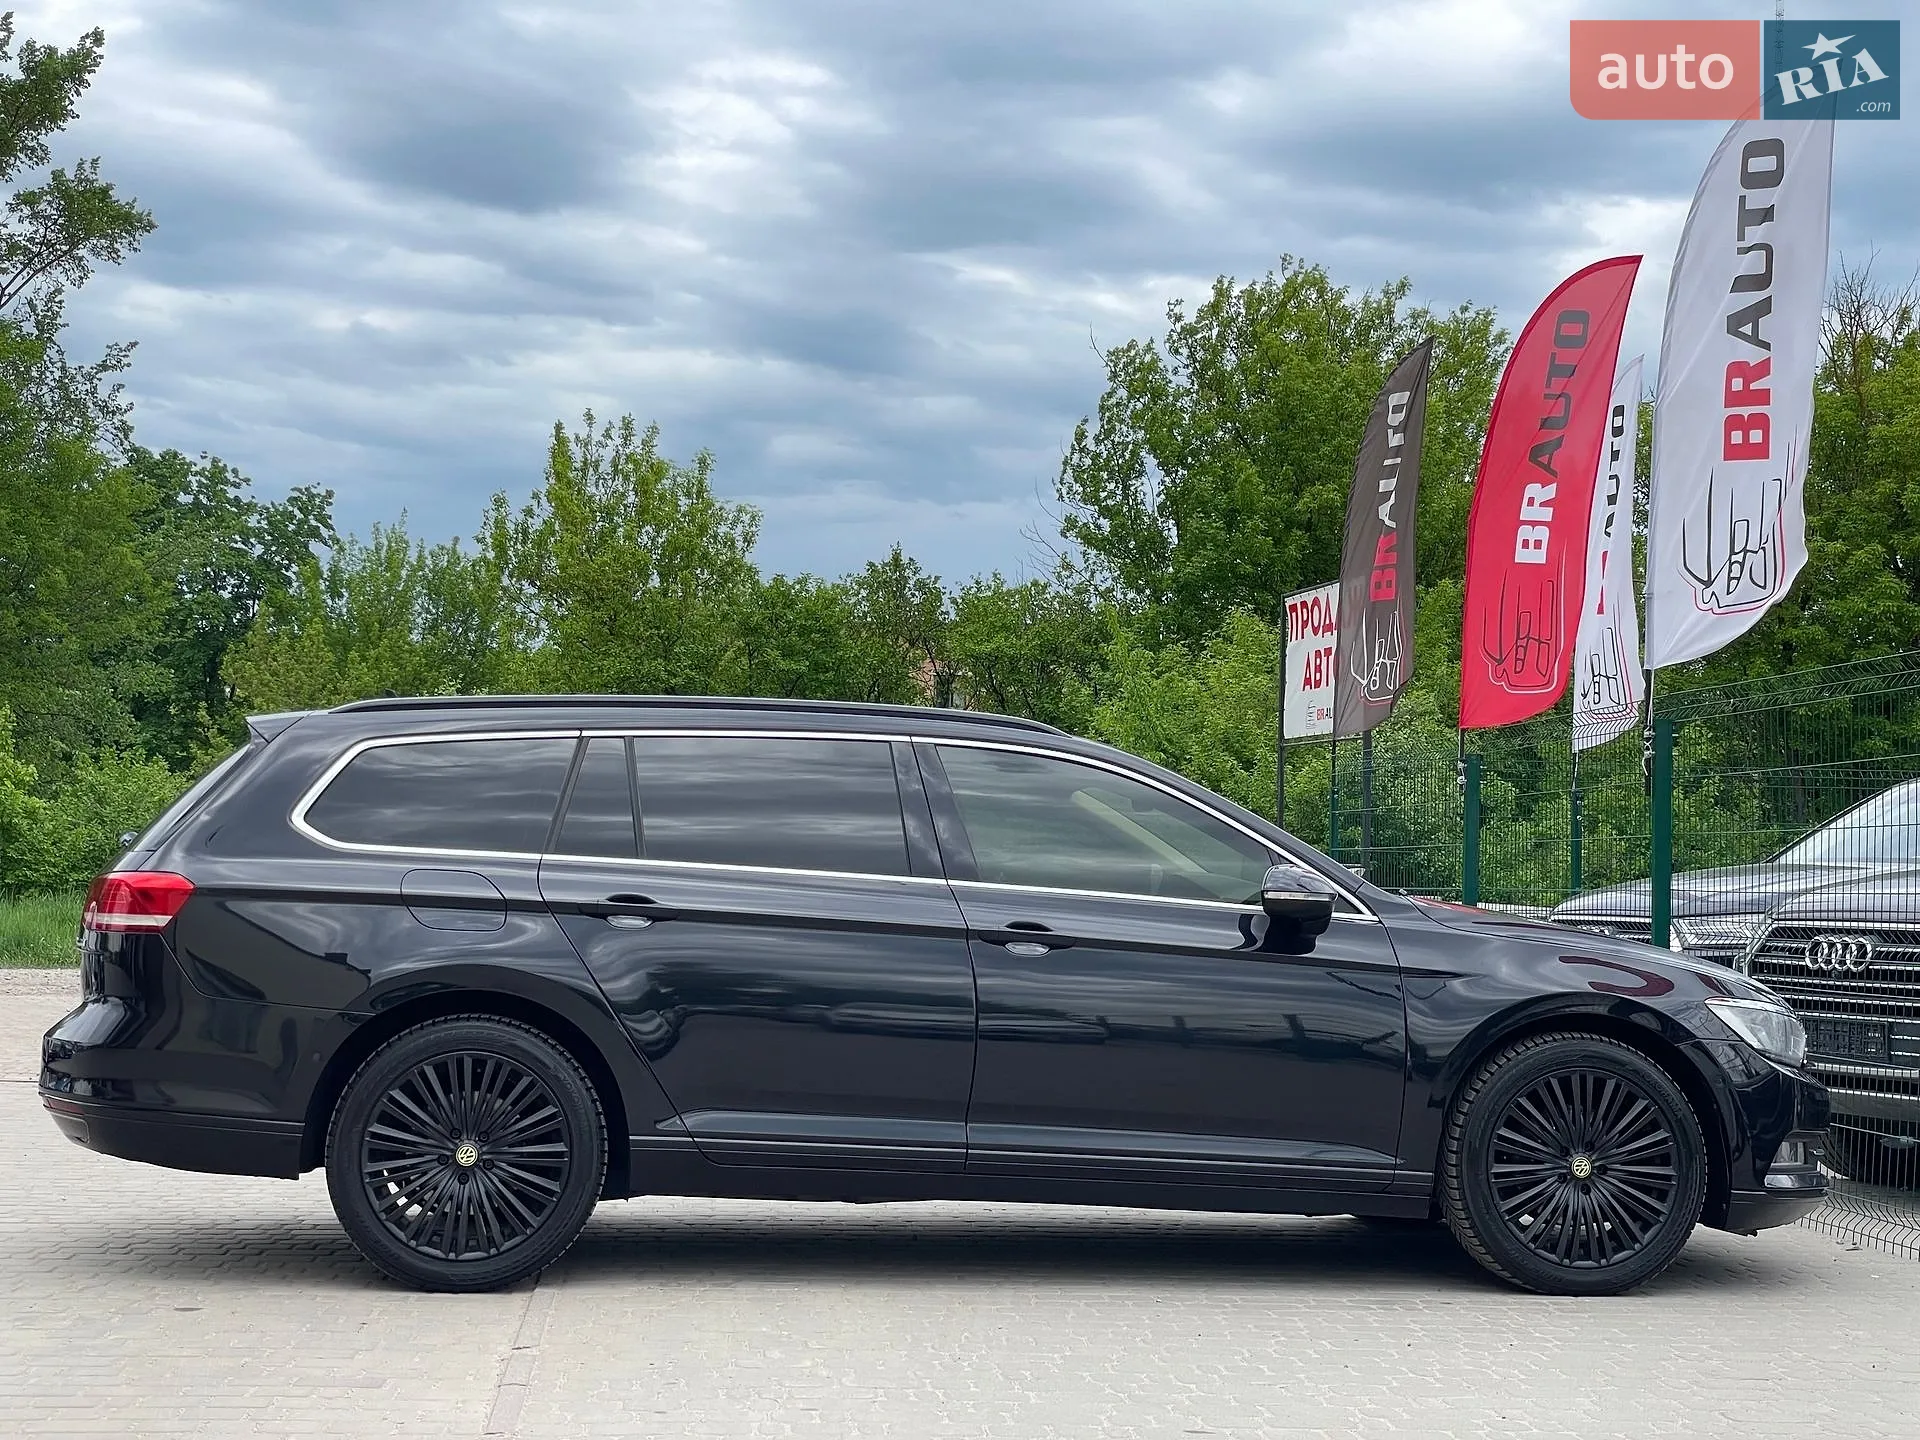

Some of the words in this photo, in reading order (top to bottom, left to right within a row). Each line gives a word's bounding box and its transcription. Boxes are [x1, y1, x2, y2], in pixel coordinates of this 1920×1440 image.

[1723, 137, 1785, 462] BRAUTO
[1515, 308, 1590, 564] BRAUTO
[1288, 592, 1338, 643] ПРОД
[1303, 646, 1335, 692] АВТ
